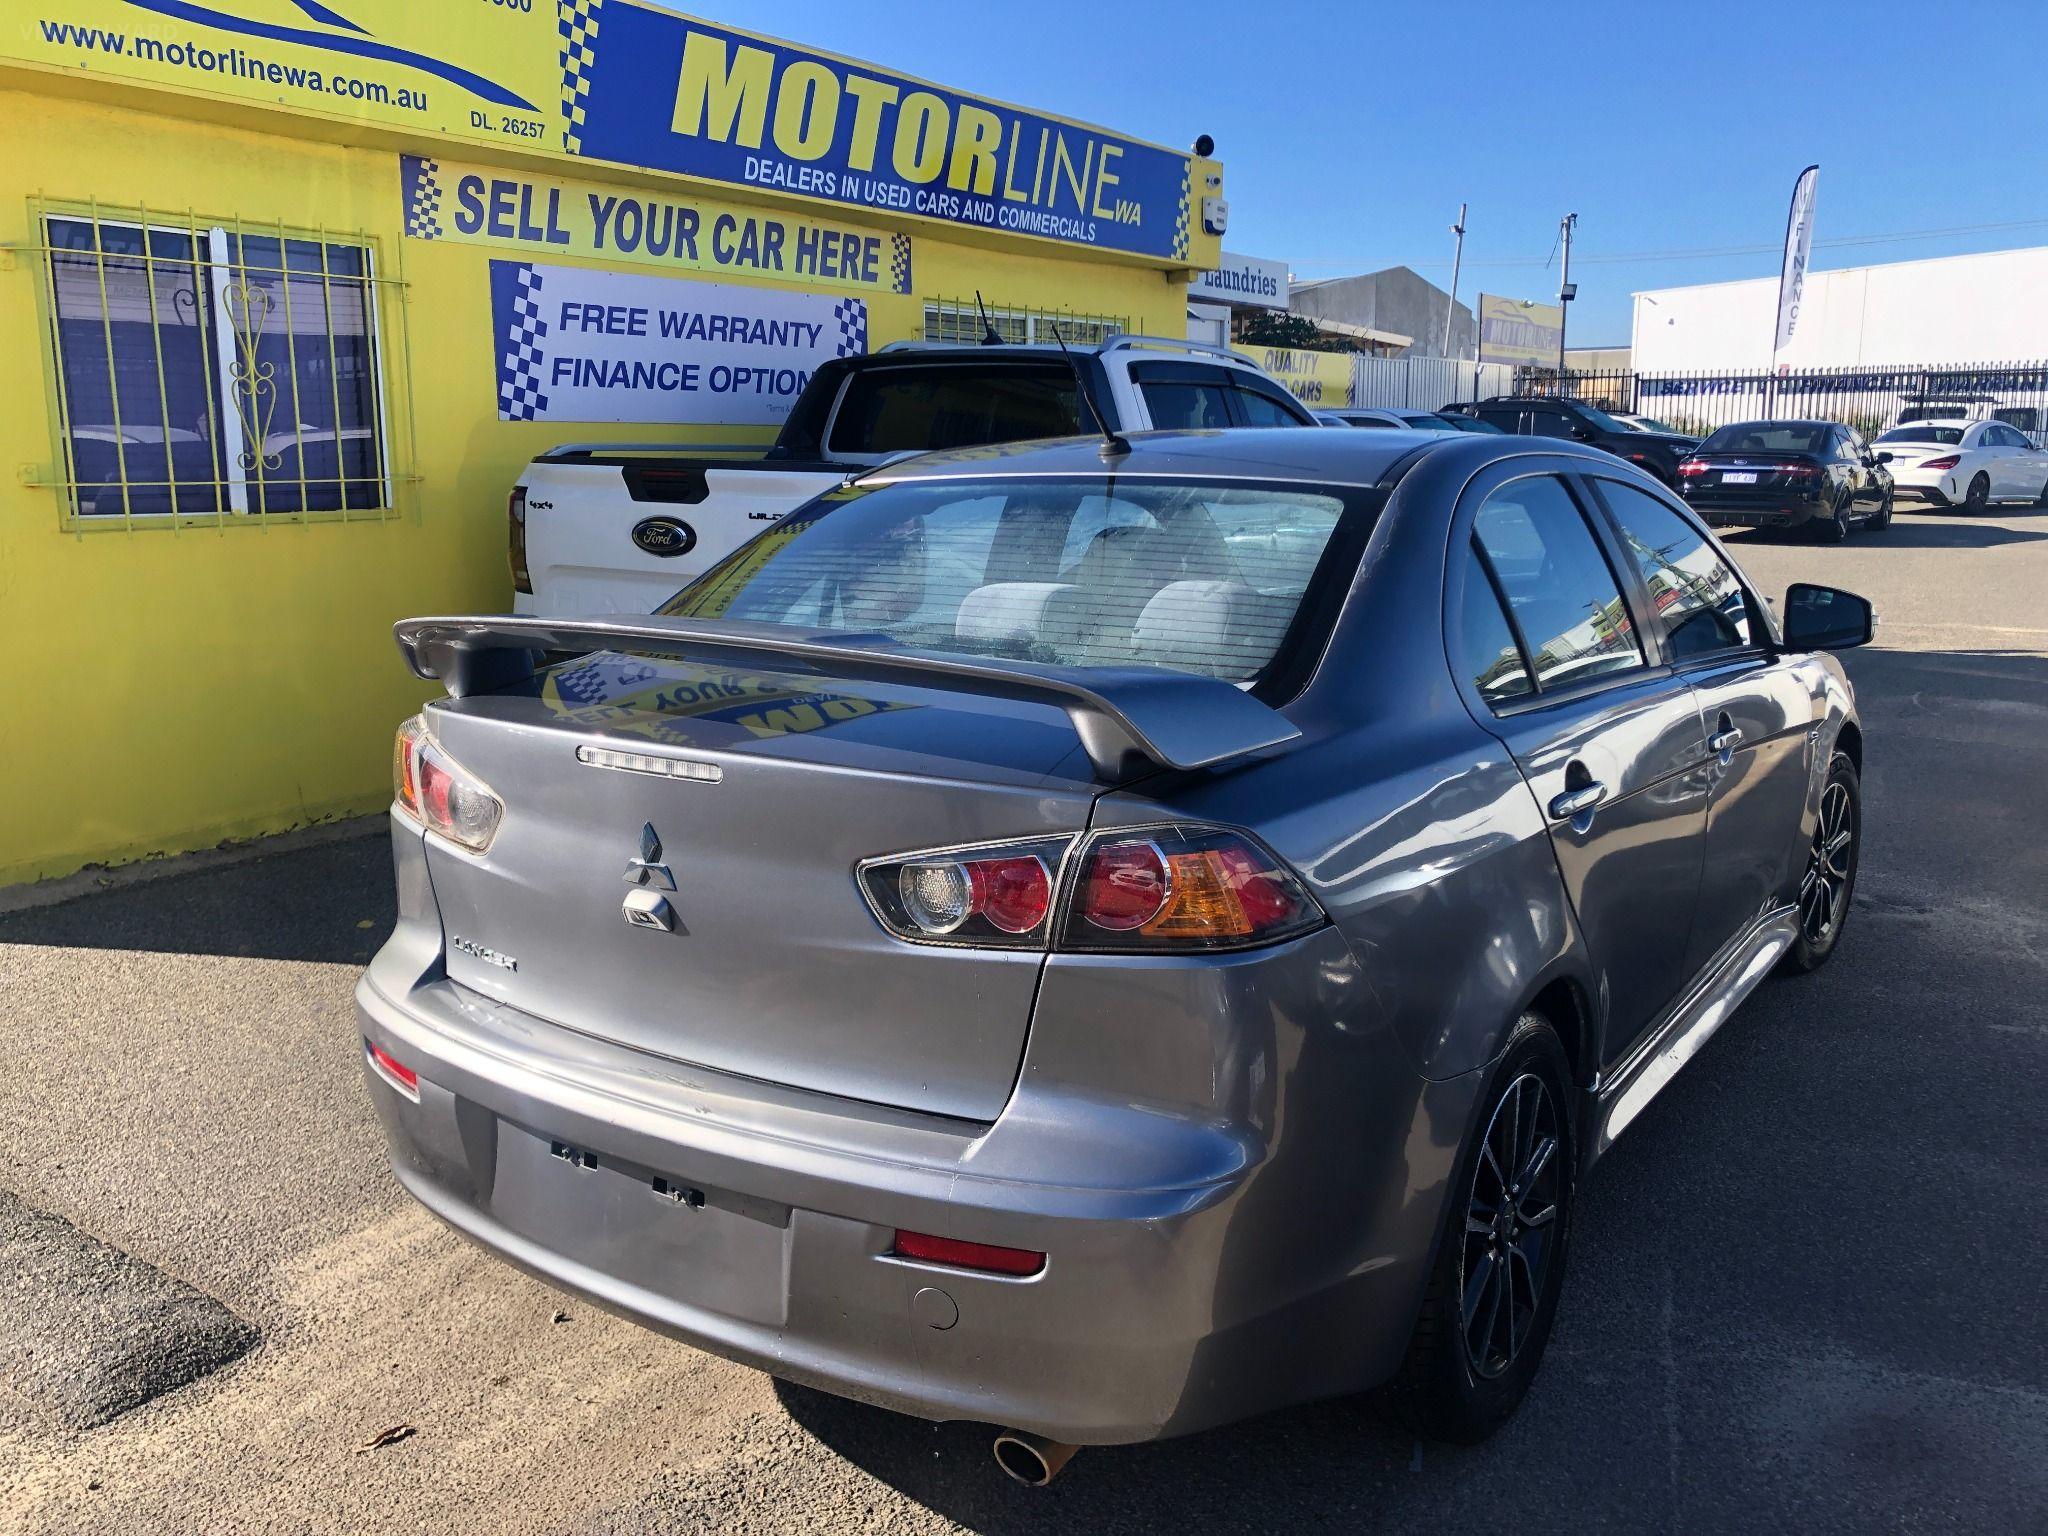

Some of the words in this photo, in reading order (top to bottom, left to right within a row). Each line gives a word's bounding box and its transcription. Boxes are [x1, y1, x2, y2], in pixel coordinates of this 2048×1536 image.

[40, 20, 428, 111] www.motorlinewa.com.au
[470, 111, 497, 131] DL.
[501, 116, 546, 139] 26257
[671, 31, 1123, 220] MOTORLINE
[744, 156, 837, 195] DEALERS
[841, 175, 860, 199] IN
[864, 180, 911, 208] USED
[915, 189, 959, 218] CARS
[962, 199, 995, 223] AND
[998, 206, 1096, 241] COMMERCIALS
[454, 175, 571, 245] SELL
[588, 193, 700, 261] YOUR
[712, 213, 785, 272] CAR
[795, 226, 881, 283] HERE
[1787, 222, 1805, 336] FINANCE
[559, 302, 648, 336] FREE
[658, 310, 823, 349] WARRANTY
[551, 357, 700, 392] FINANCE
[1264, 350, 1319, 375] QUALITY
[1291, 380, 1322, 402] CARS
[643, 527, 672, 545] Ford
[453, 935, 518, 972] LANCER
